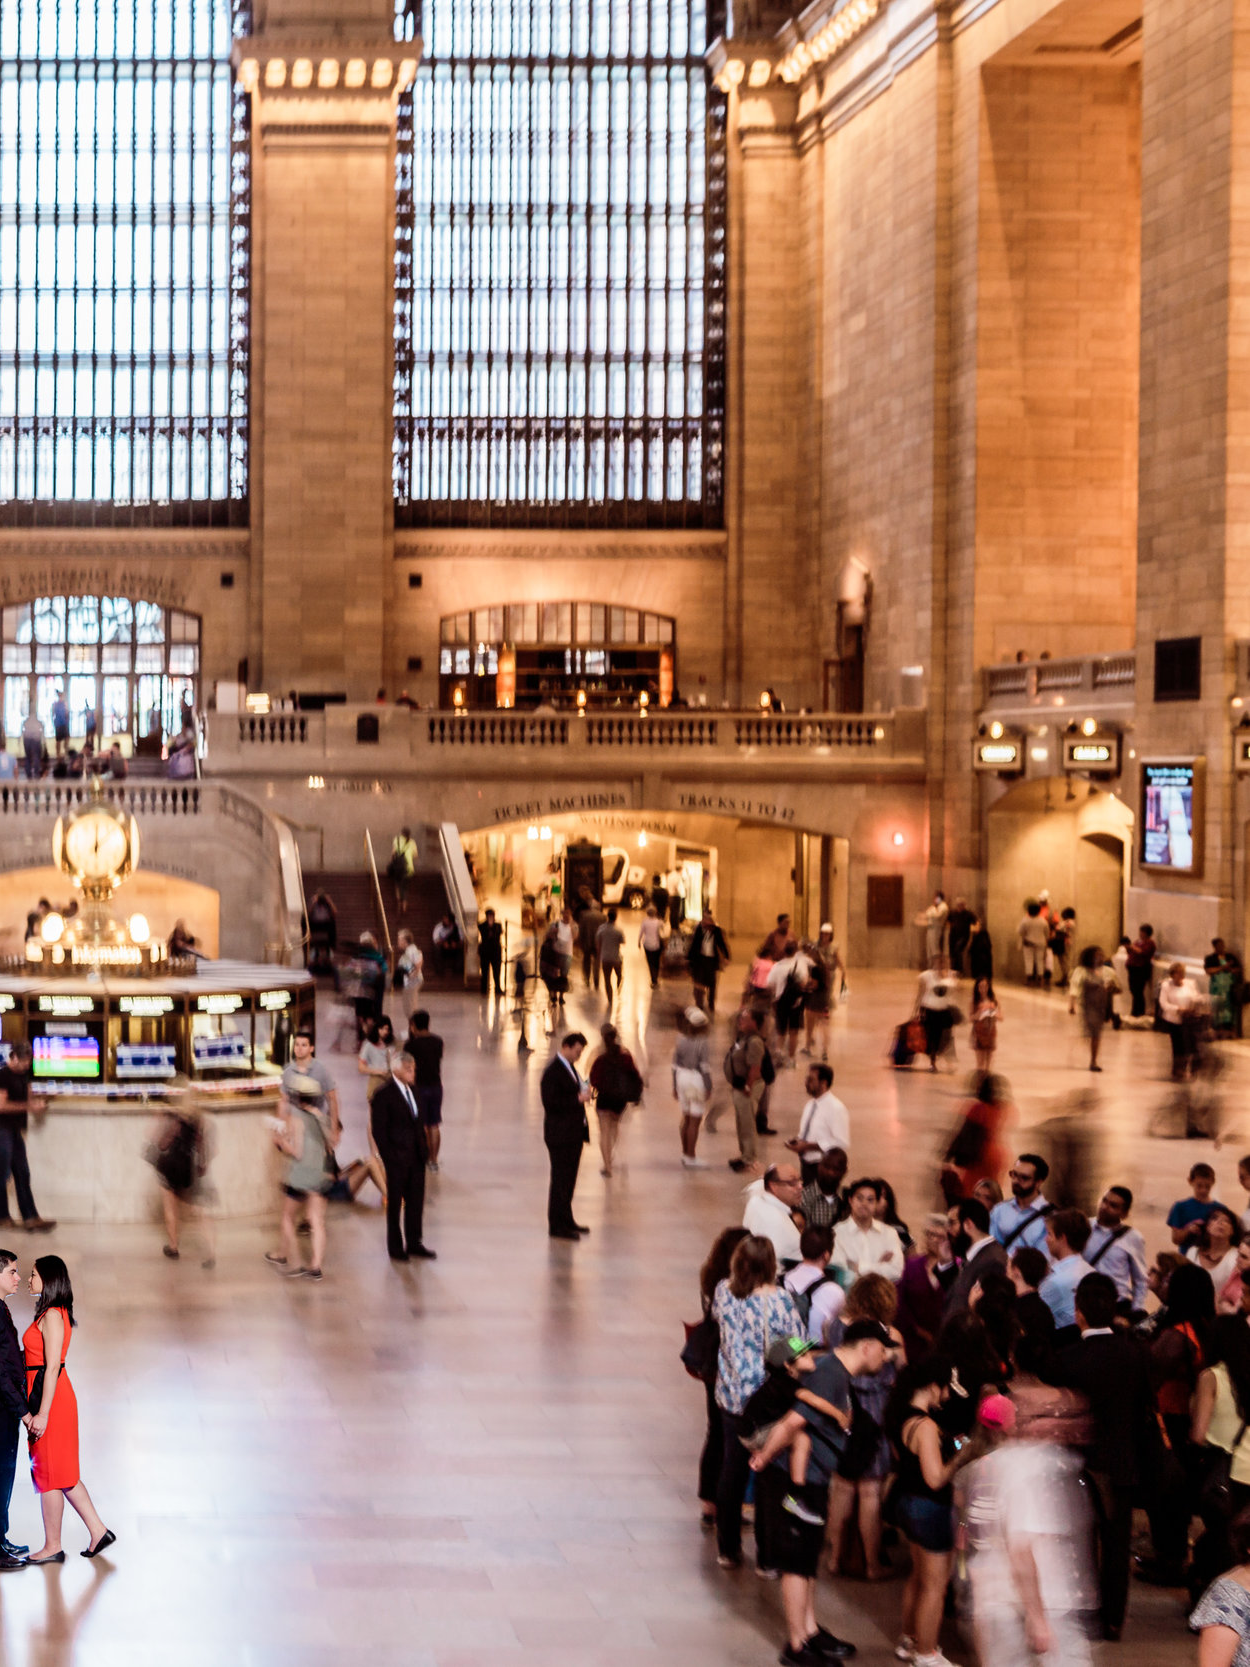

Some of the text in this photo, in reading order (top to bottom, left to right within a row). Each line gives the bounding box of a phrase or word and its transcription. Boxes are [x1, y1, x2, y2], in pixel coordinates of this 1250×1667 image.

[494, 792, 626, 821] TICKET MACHINES
[678, 793, 736, 809] TRACKS
[756, 801, 776, 816] TO
[579, 814, 677, 834] WAITING ROOM
